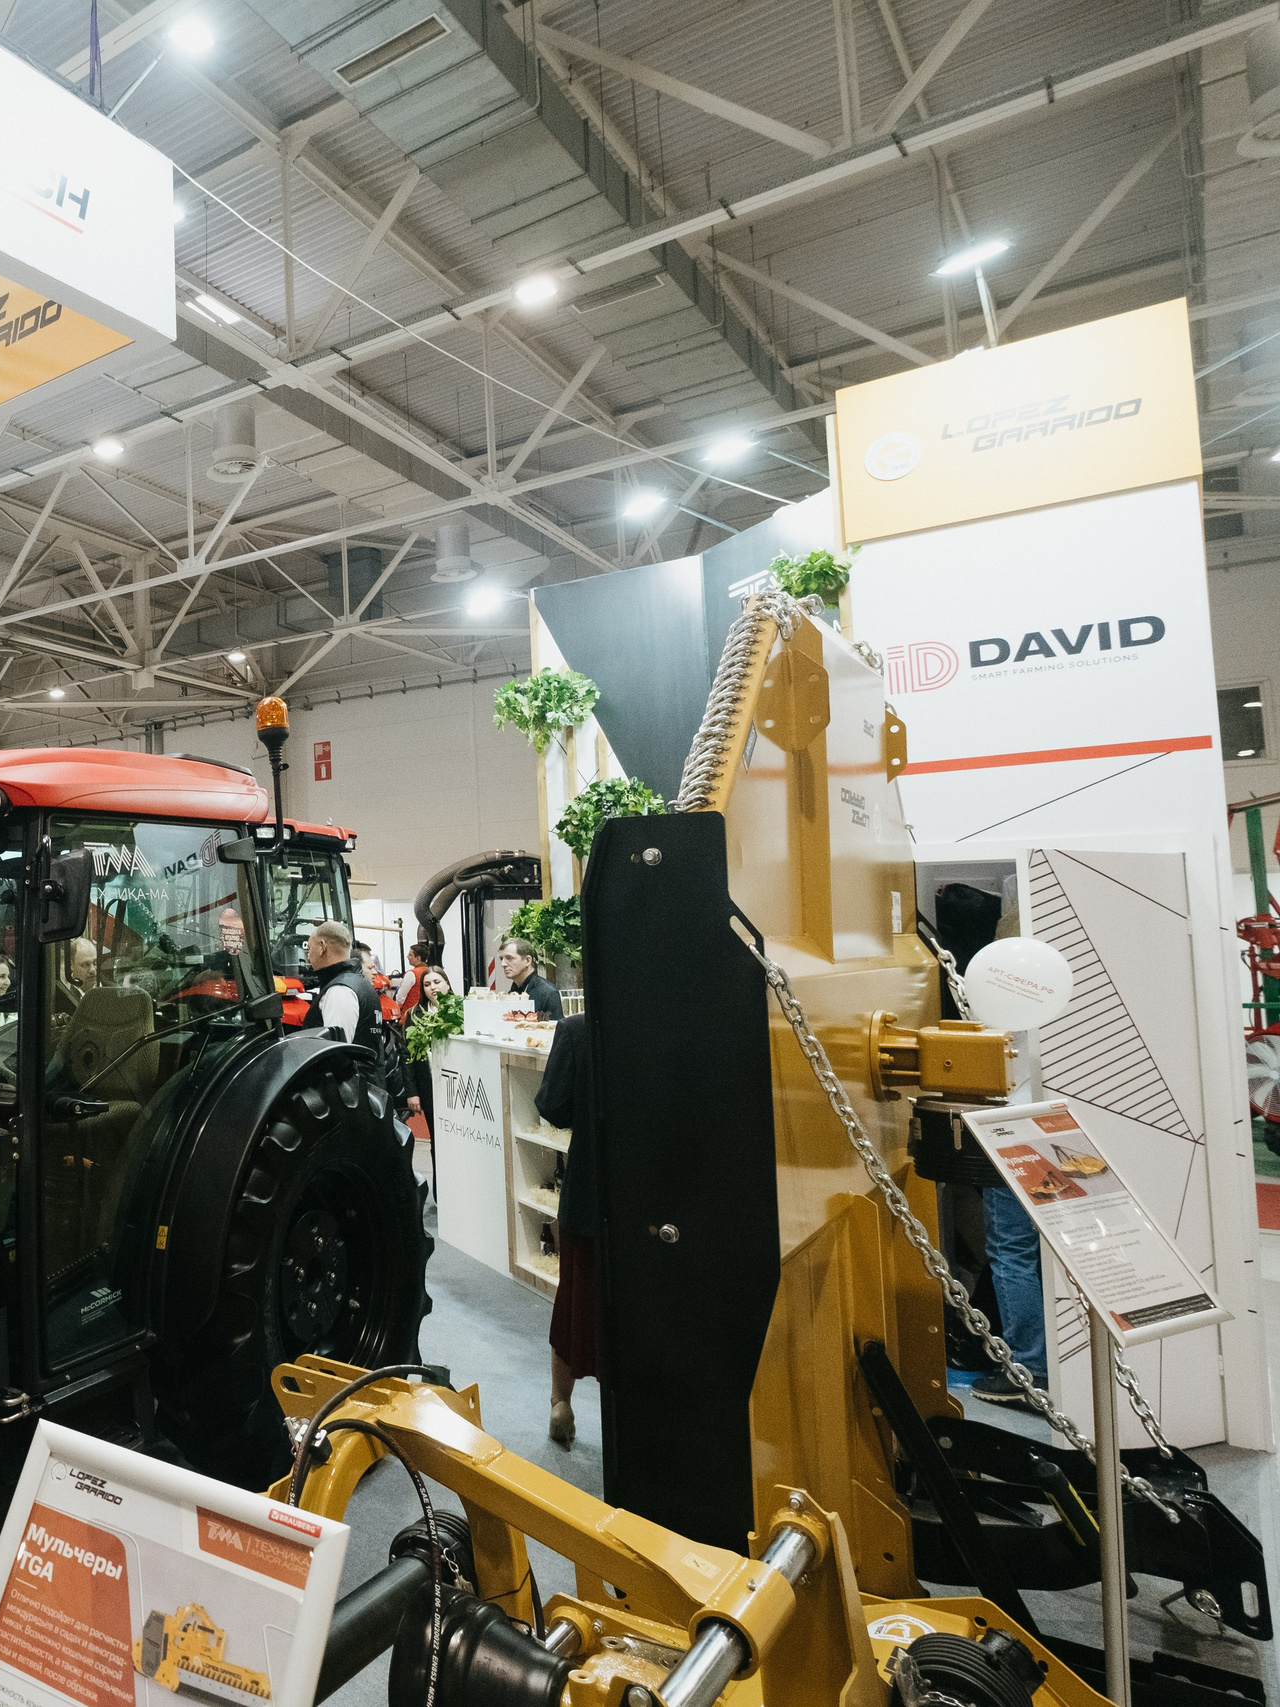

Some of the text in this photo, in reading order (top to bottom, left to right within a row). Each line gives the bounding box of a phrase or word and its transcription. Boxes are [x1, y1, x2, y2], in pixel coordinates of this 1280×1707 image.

[940, 394, 1070, 440] LOPEZ
[972, 397, 1142, 453] GARRIDO
[969, 615, 1166, 668] DAVID
[971, 653, 1139, 681] SMART FARMING SOLUTIONS
[987, 966, 1055, 995] АРТ-СФЕРА.РФ
[438, 1117, 502, 1151] ТЕХНИКА-МА
[80, 1289, 122, 1314] McCORMICK
[70, 1468, 107, 1489] LOPEZ
[75, 1481, 123, 1506] GARRIDO
[279, 1515, 316, 1533] BRAUBERG
[19, 1550, 54, 1582] TGA
[26, 1523, 123, 1580] Мульчеры
[251, 1549, 308, 1577] MAJOR AGRO
[6, 1603, 127, 1667] междурядьев в садах и виноград-
[10, 1588, 129, 1652] Отлично подойдет для расчистки
[11, 1651, 18, 1660] и
[43, 1667, 66, 1685] после
[24, 1624, 61, 1650] Возможно
[61, 1645, 94, 1667] кошение
[94, 1661, 123, 1681] сорной
[54, 1657, 61, 1665] а
[61, 1660, 83, 1677] также
[83, 1672, 133, 1703] измельчение
